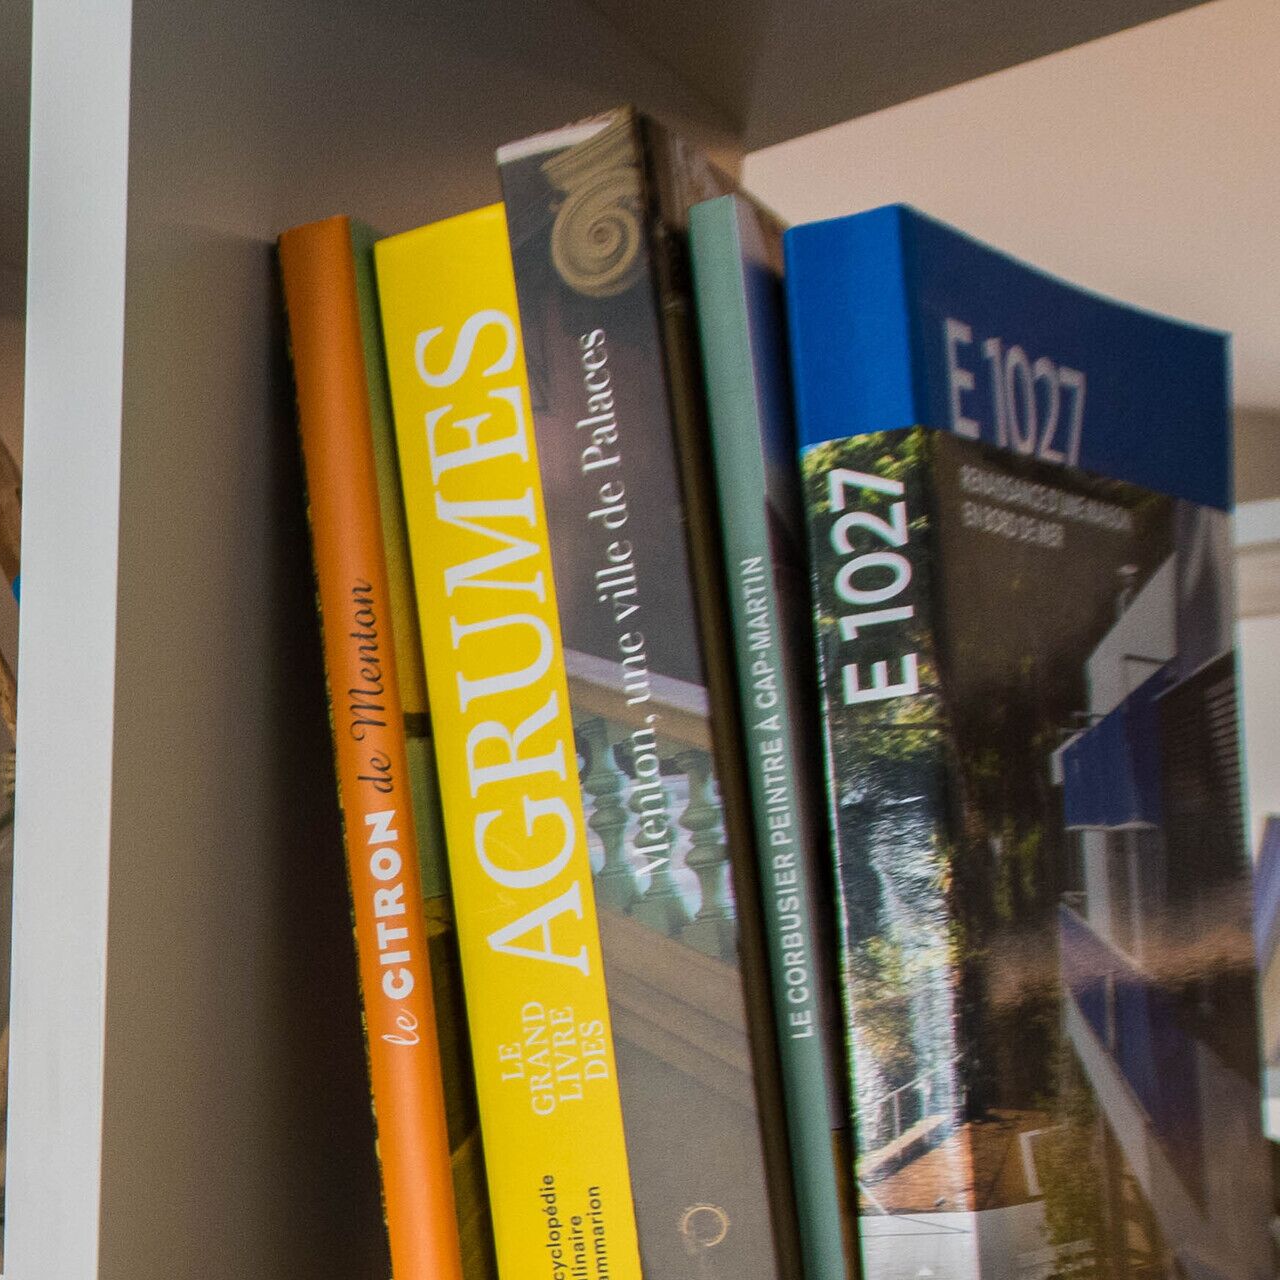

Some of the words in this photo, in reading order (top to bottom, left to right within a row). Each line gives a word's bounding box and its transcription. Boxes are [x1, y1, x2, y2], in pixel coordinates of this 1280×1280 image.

[576, 328, 621, 477] Palaces
[945, 317, 981, 441] E
[983, 334, 1087, 467] 1027
[588, 480, 628, 530] de
[827, 467, 915, 643] 1027
[596, 540, 640, 622] ville
[741, 554, 778, 710] CAP-MARTIN
[348, 578, 387, 741] Menton
[414, 308, 589, 976] AGRUMES
[619, 630, 652, 706] une
[841, 651, 921, 706] E
[357, 751, 393, 793] de
[634, 714, 671, 876] Menton,
[761, 738, 794, 846] PEINTRE
[364, 809, 415, 1000] CITRON
[772, 850, 810, 1005] CORBUSIER
[381, 1008, 420, 1046] le
[498, 1042, 525, 1081] LE
[521, 1000, 557, 1116] GRAND
[548, 1005, 584, 1103] LIVRE
[579, 1019, 609, 1081] DES
[791, 1010, 815, 1040] LE
